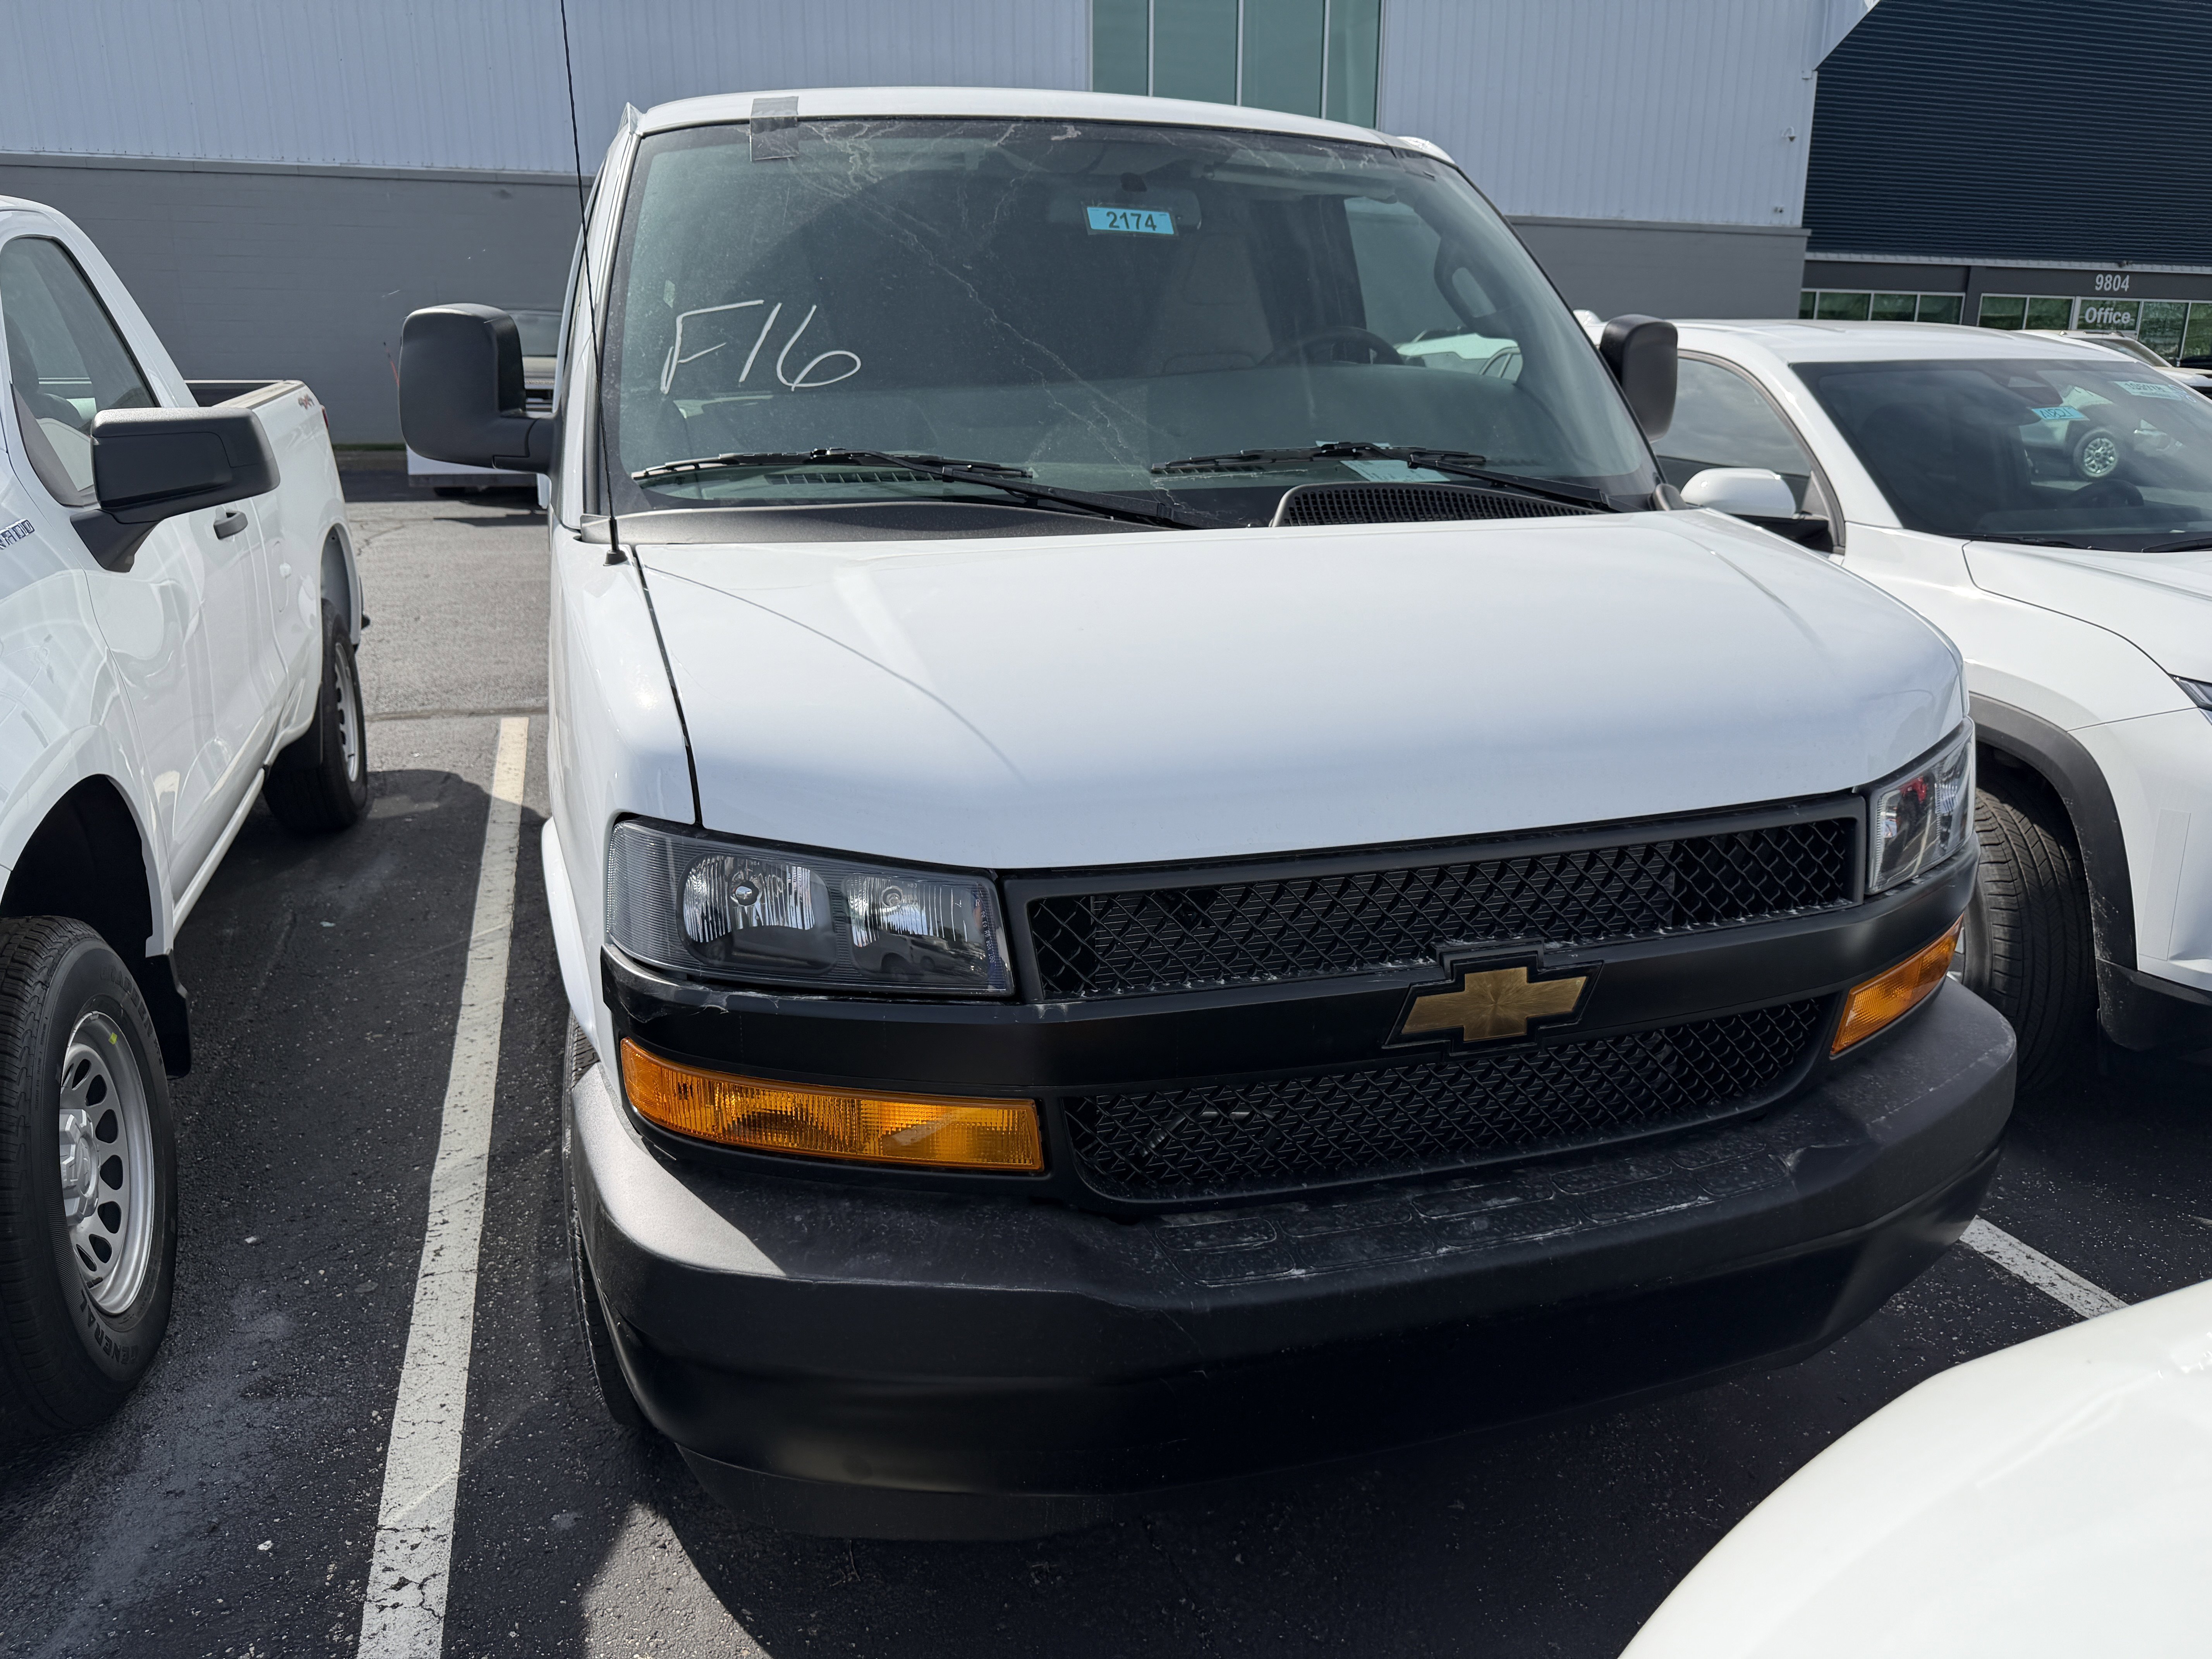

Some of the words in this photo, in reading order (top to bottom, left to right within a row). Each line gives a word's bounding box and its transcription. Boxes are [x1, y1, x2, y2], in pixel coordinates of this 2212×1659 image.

[1106, 211, 1157, 231] 2174
[2095, 274, 2130, 292] 9804
[2085, 307, 2131, 324] Office
[660, 300, 861, 394] F16
